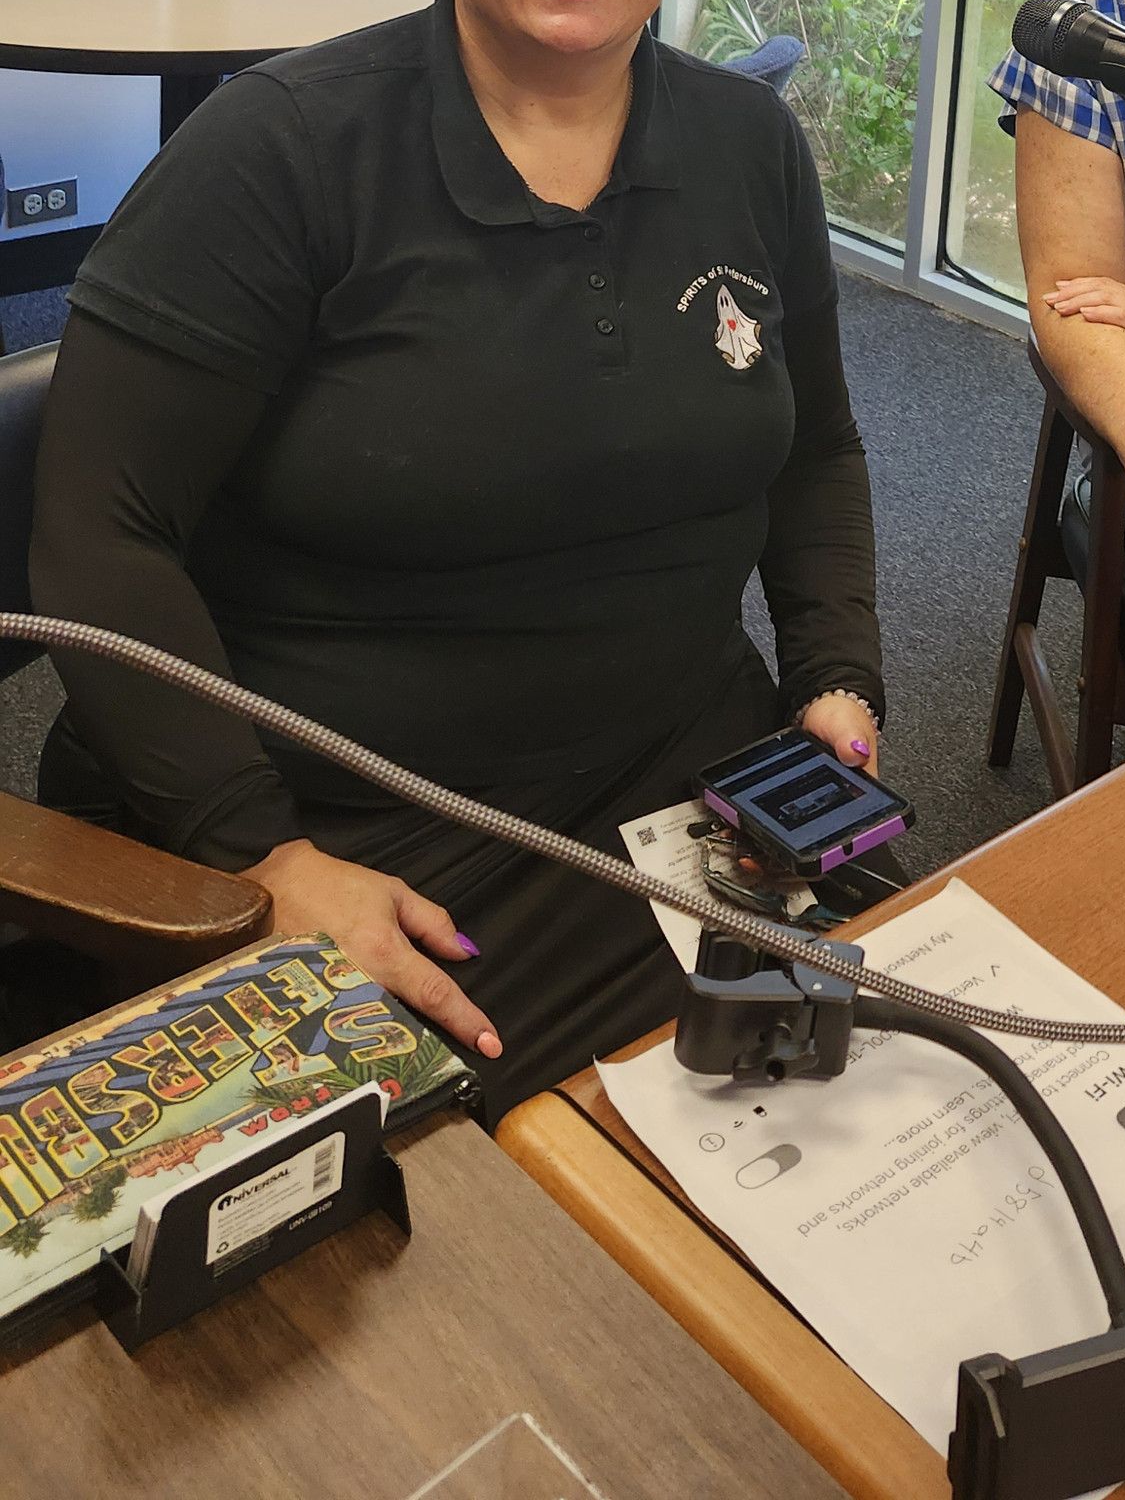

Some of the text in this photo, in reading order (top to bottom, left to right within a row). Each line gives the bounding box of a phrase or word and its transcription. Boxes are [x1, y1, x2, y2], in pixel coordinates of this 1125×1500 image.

[676, 275, 708, 313] SPIRITS
[707, 266, 717, 280] of
[882, 942, 932, 976] Networ
[252, 1001, 418, 1088] ST
[1055, 1049, 1110, 1087] Connect
[0, 950, 375, 1237] PETERSBU
[931, 1090, 975, 1120] Learn
[962, 1091, 1006, 1124] ettings
[1039, 1083, 1058, 1096] to
[946, 1121, 966, 1139] for
[969, 1122, 1003, 1147] view
[894, 1132, 943, 1170] joining
[909, 1143, 970, 1187] available
[828, 1166, 896, 1216] networks
[835, 1183, 911, 1234] networks,
[795, 1209, 826, 1238] and
